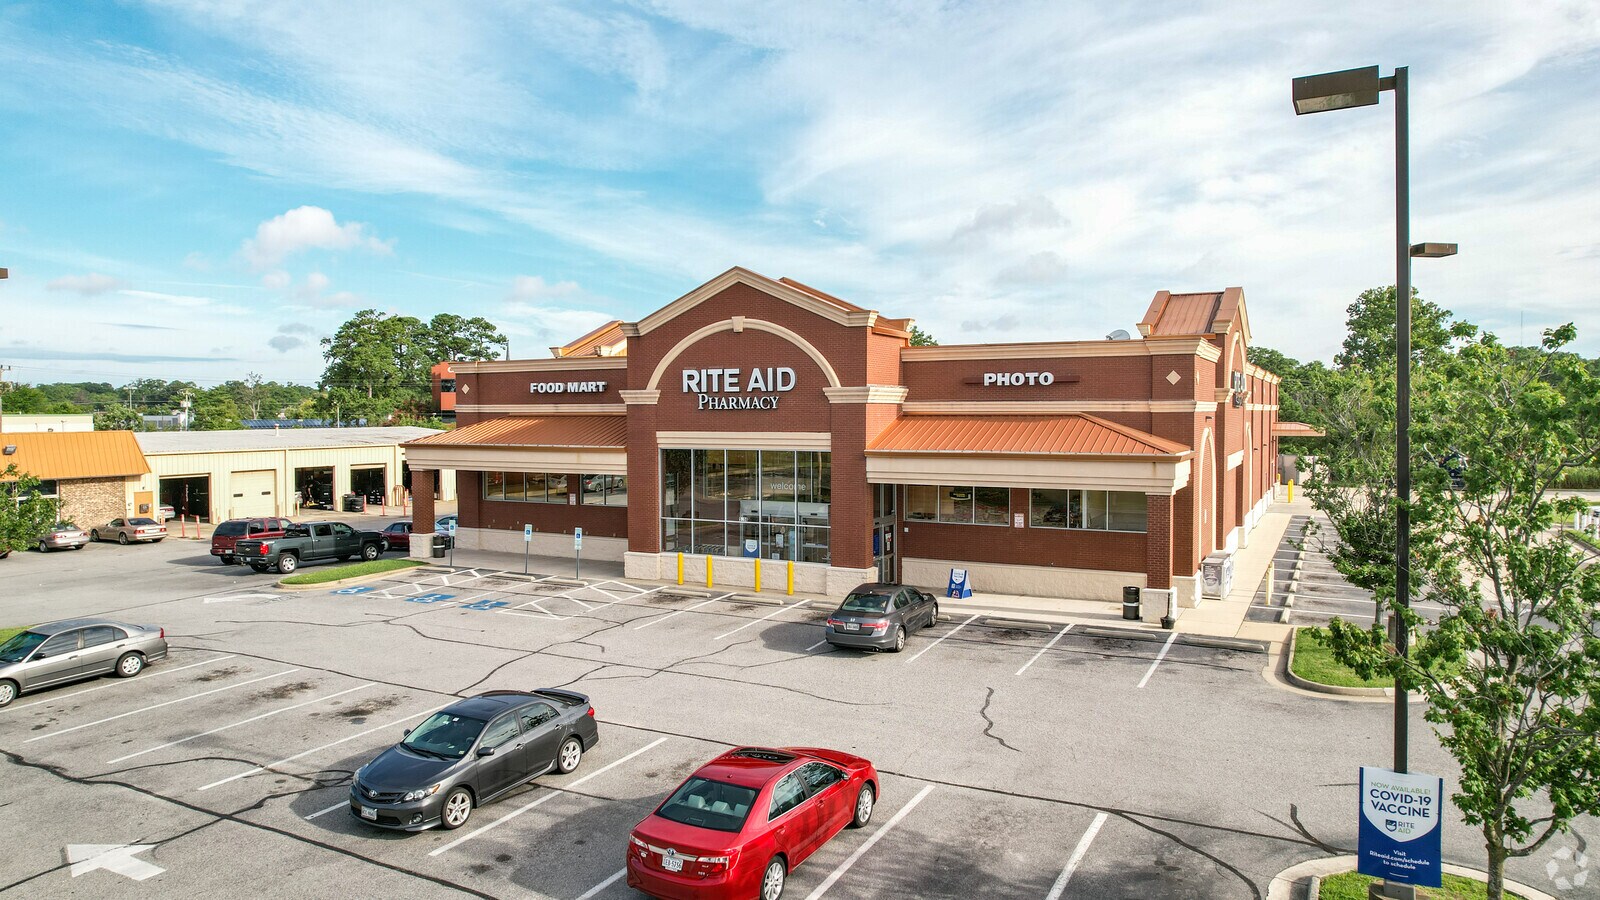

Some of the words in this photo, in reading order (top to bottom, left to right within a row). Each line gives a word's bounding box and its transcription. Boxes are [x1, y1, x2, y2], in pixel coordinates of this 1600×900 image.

[529, 382, 565, 393] FOOD
[567, 381, 608, 393] MART
[682, 368, 740, 393] RITE
[746, 367, 796, 392] AID
[983, 371, 1055, 387] PHOTO
[697, 393, 779, 410] PHARMACY
[1370, 781, 1390, 789] NOW
[1390, 785, 1431, 795] AVAILABLE!
[1370, 788, 1432, 806] COVID-19
[1371, 799, 1430, 818] VACCINE
[1398, 821, 1415, 829] RITE
[1390, 862, 1416, 870] schedule
